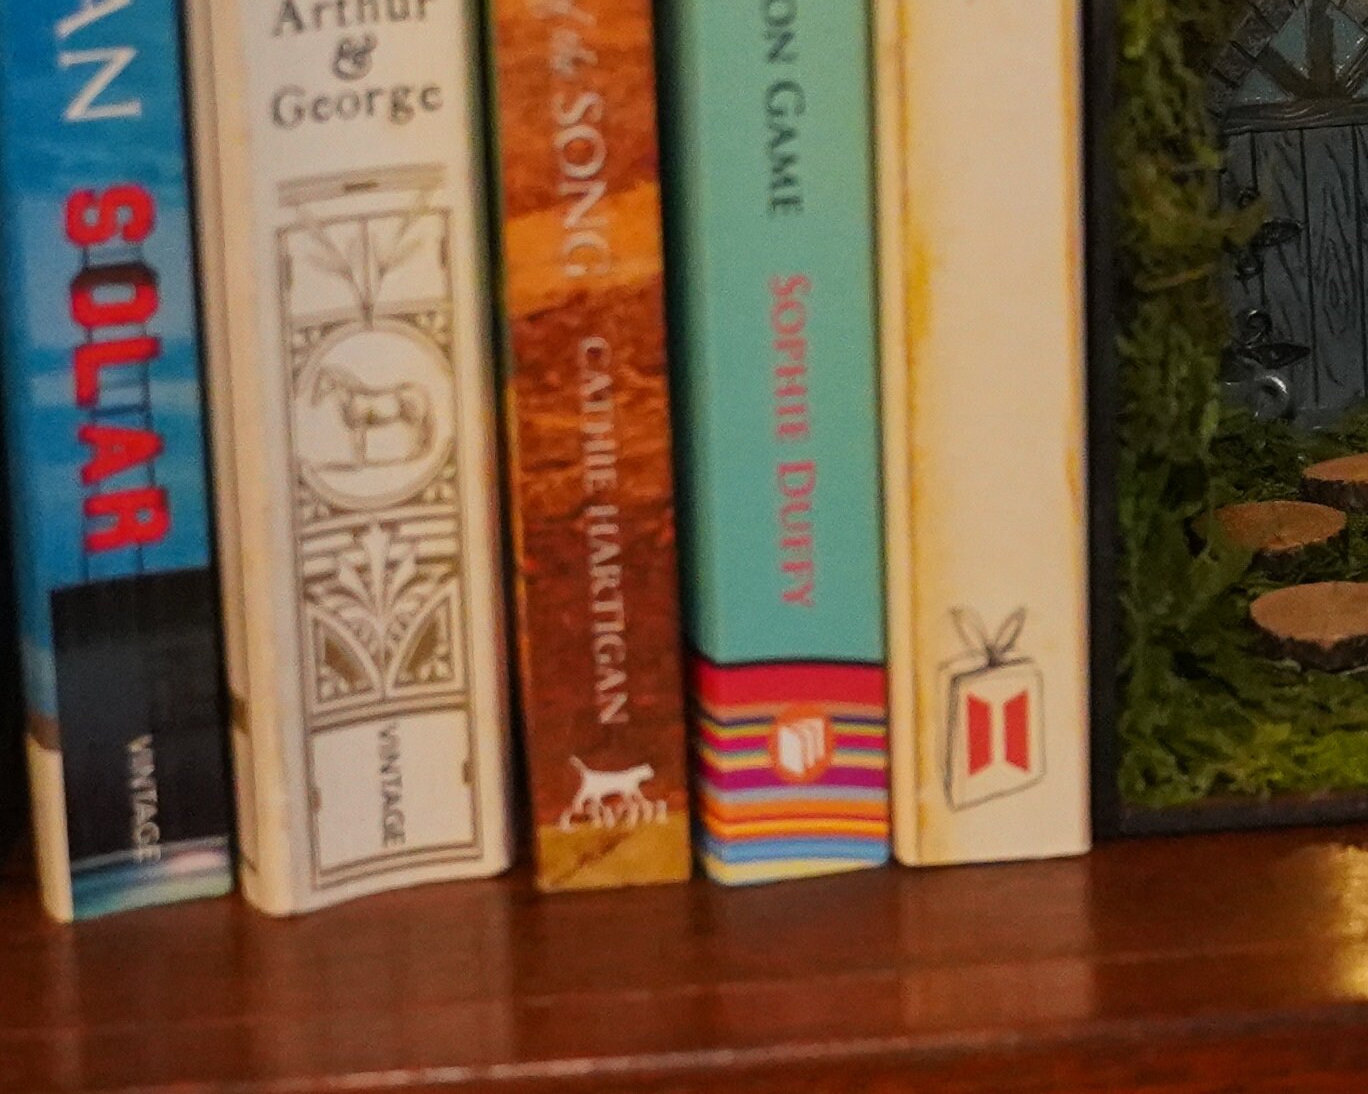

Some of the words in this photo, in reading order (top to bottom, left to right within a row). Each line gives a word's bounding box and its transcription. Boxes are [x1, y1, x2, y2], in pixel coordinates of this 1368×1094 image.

[271, 78, 445, 129] George
[331, 32, 378, 82] &
[552, 90, 613, 278] SONG
[63, 184, 173, 552] SOLAR
[583, 506, 629, 726] HARTIGAN
[126, 733, 161, 863] VINTAGE
[379, 725, 407, 848] VINTAGE
